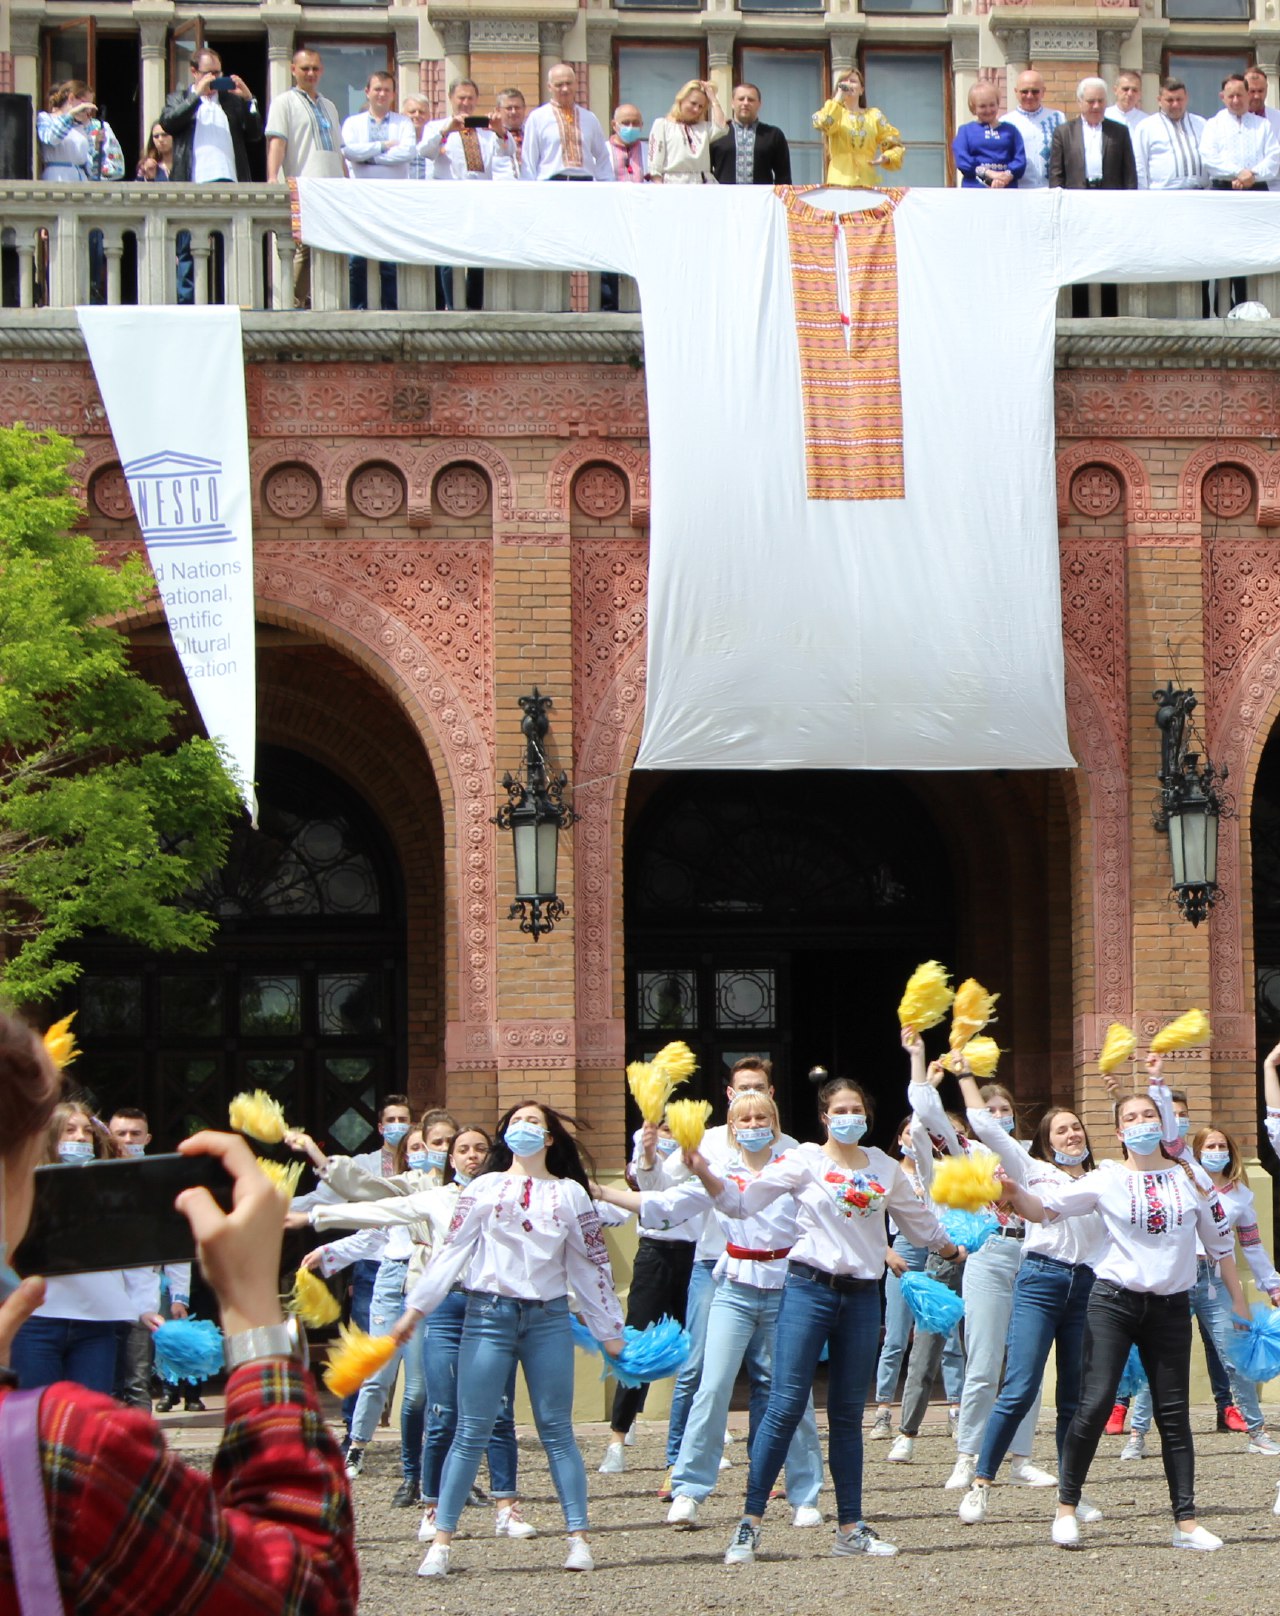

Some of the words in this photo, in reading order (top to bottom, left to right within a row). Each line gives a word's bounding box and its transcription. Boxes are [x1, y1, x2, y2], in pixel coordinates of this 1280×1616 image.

[137, 476, 219, 528] NESCO
[172, 560, 242, 580] Nations
[160, 583, 233, 606] ational,
[169, 610, 223, 631] entific
[177, 632, 231, 655] ultural
[185, 660, 238, 679] zation
